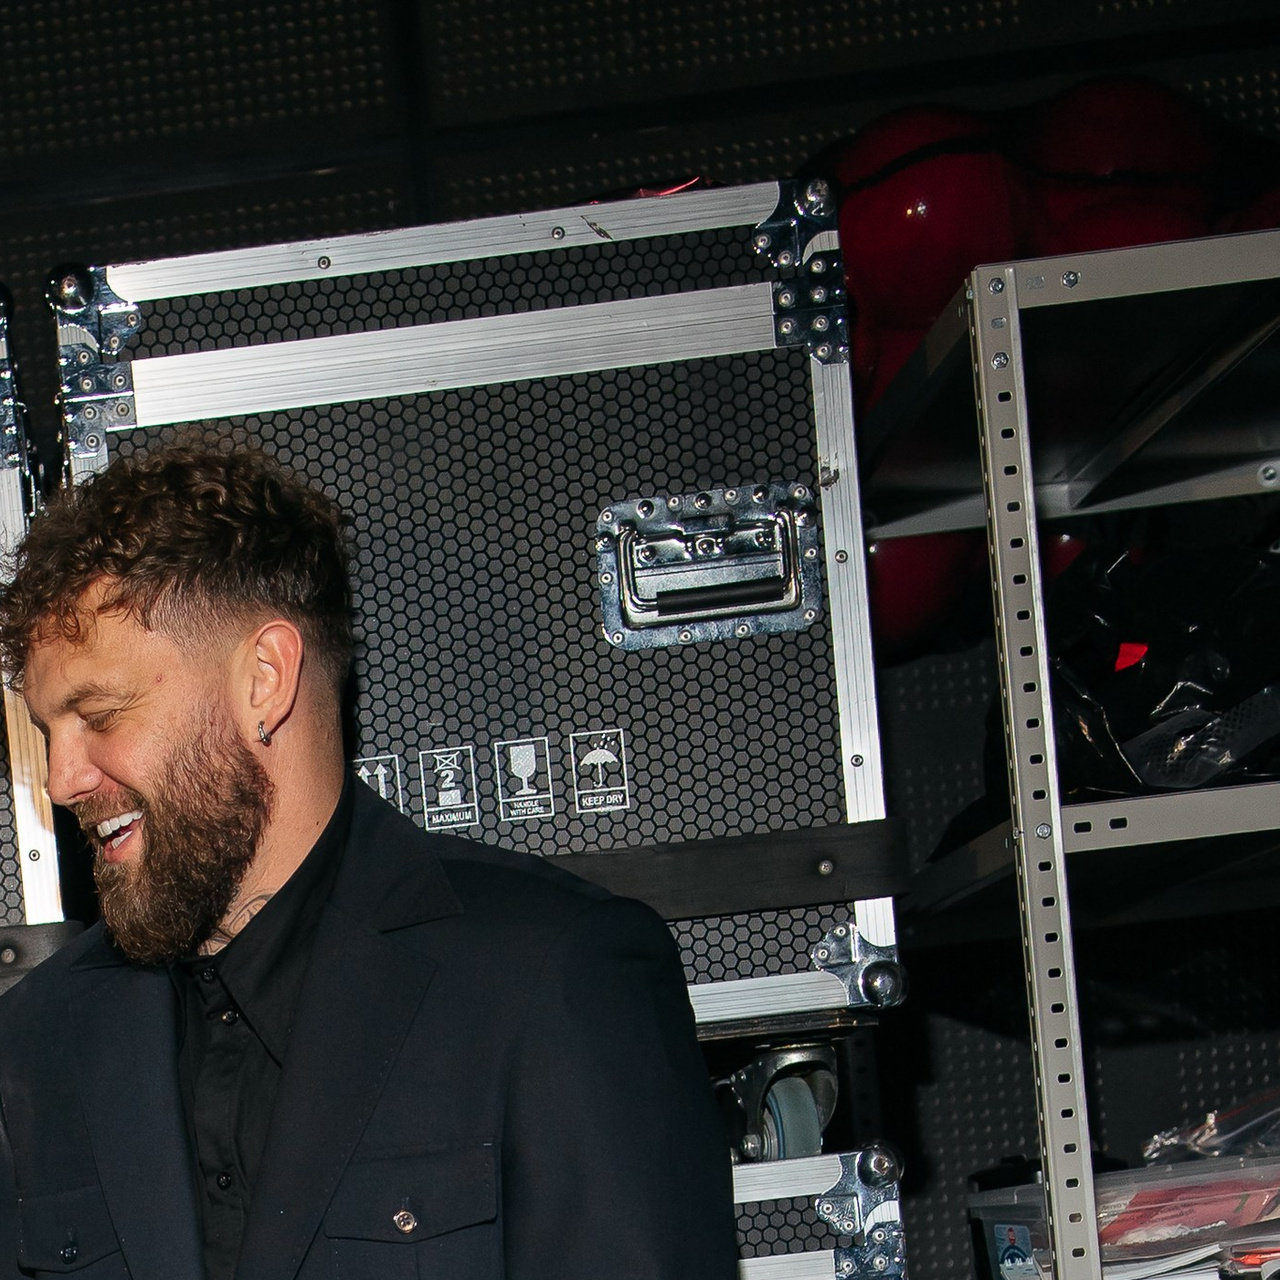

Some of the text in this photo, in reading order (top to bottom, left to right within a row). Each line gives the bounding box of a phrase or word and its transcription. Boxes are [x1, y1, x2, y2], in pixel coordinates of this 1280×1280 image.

[440, 769, 456, 788] 2
[581, 793, 624, 806] KEEP DRY
[432, 811, 472, 823] MAXIMUM
